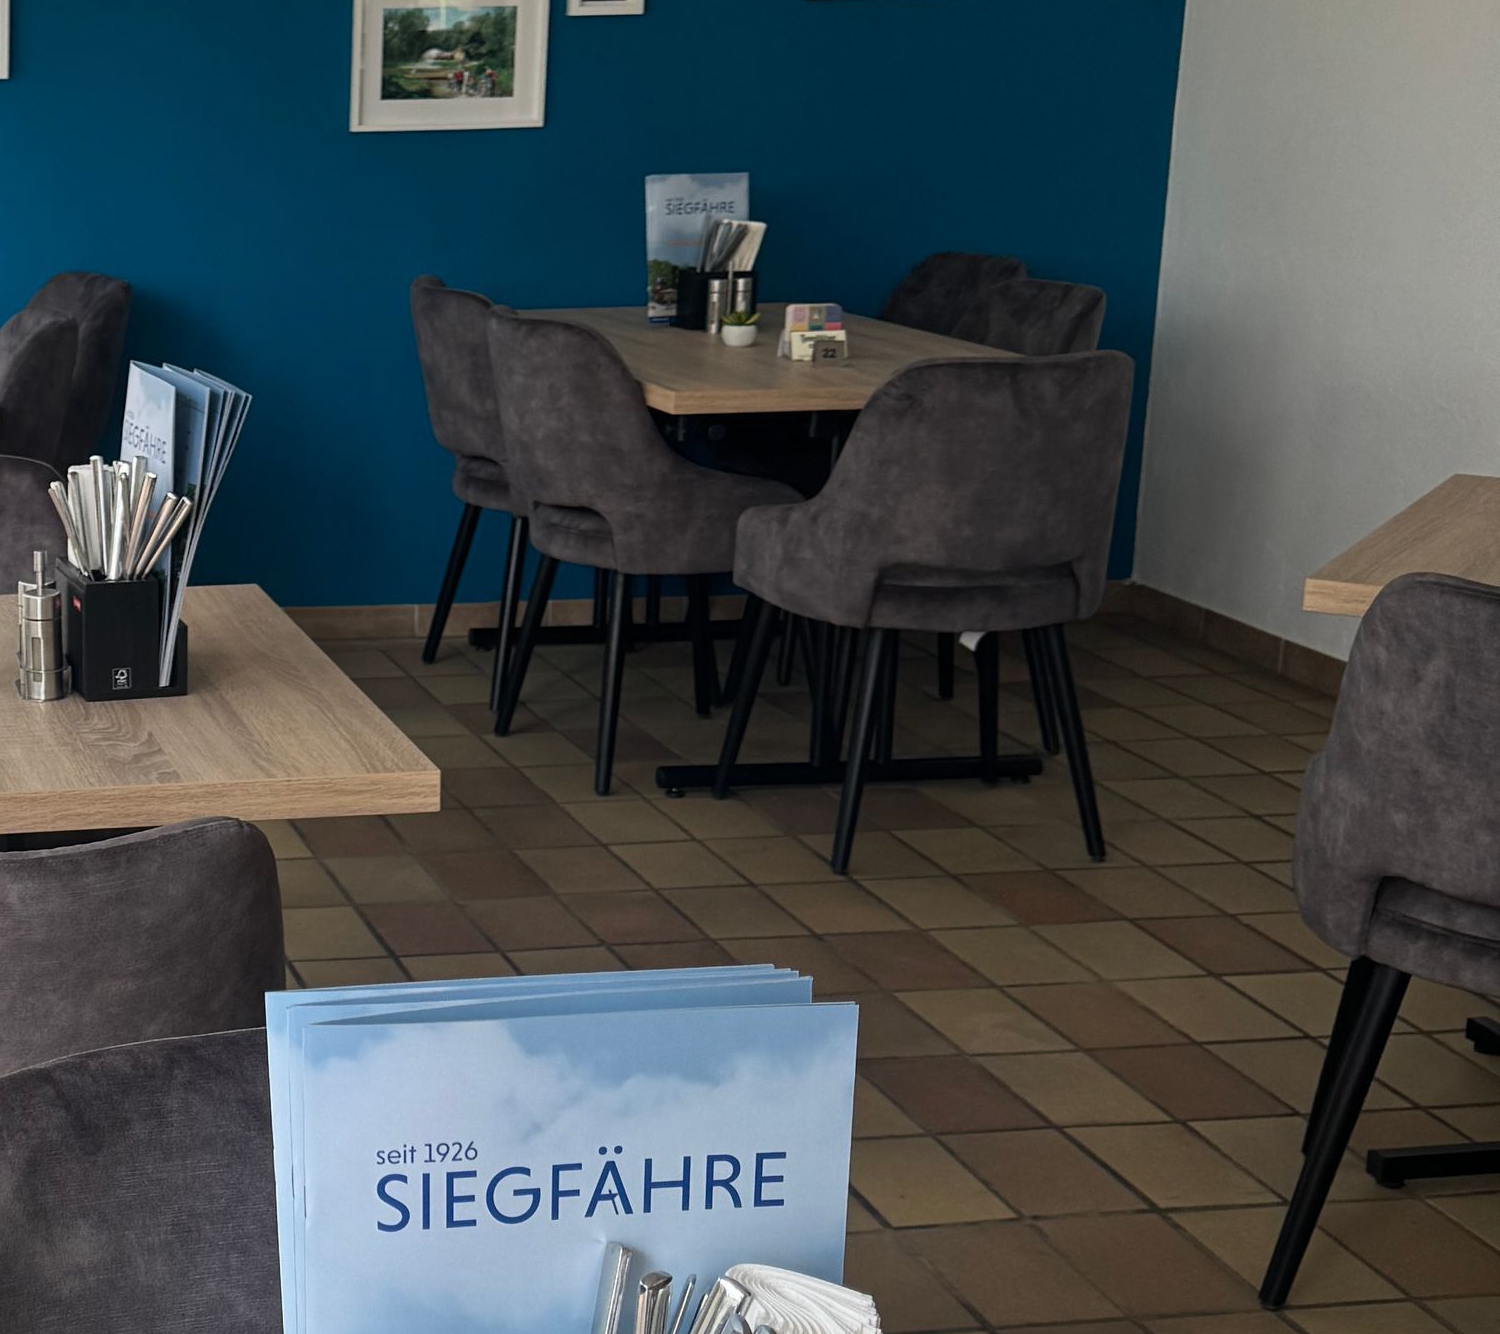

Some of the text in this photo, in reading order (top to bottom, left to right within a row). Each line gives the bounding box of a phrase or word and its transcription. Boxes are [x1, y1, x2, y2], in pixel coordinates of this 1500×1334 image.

[664, 198, 735, 216] SIEGFÄHRE
[376, 1141, 478, 1165] seit 1926
[376, 1145, 787, 1233] SIEGFÄHRE
